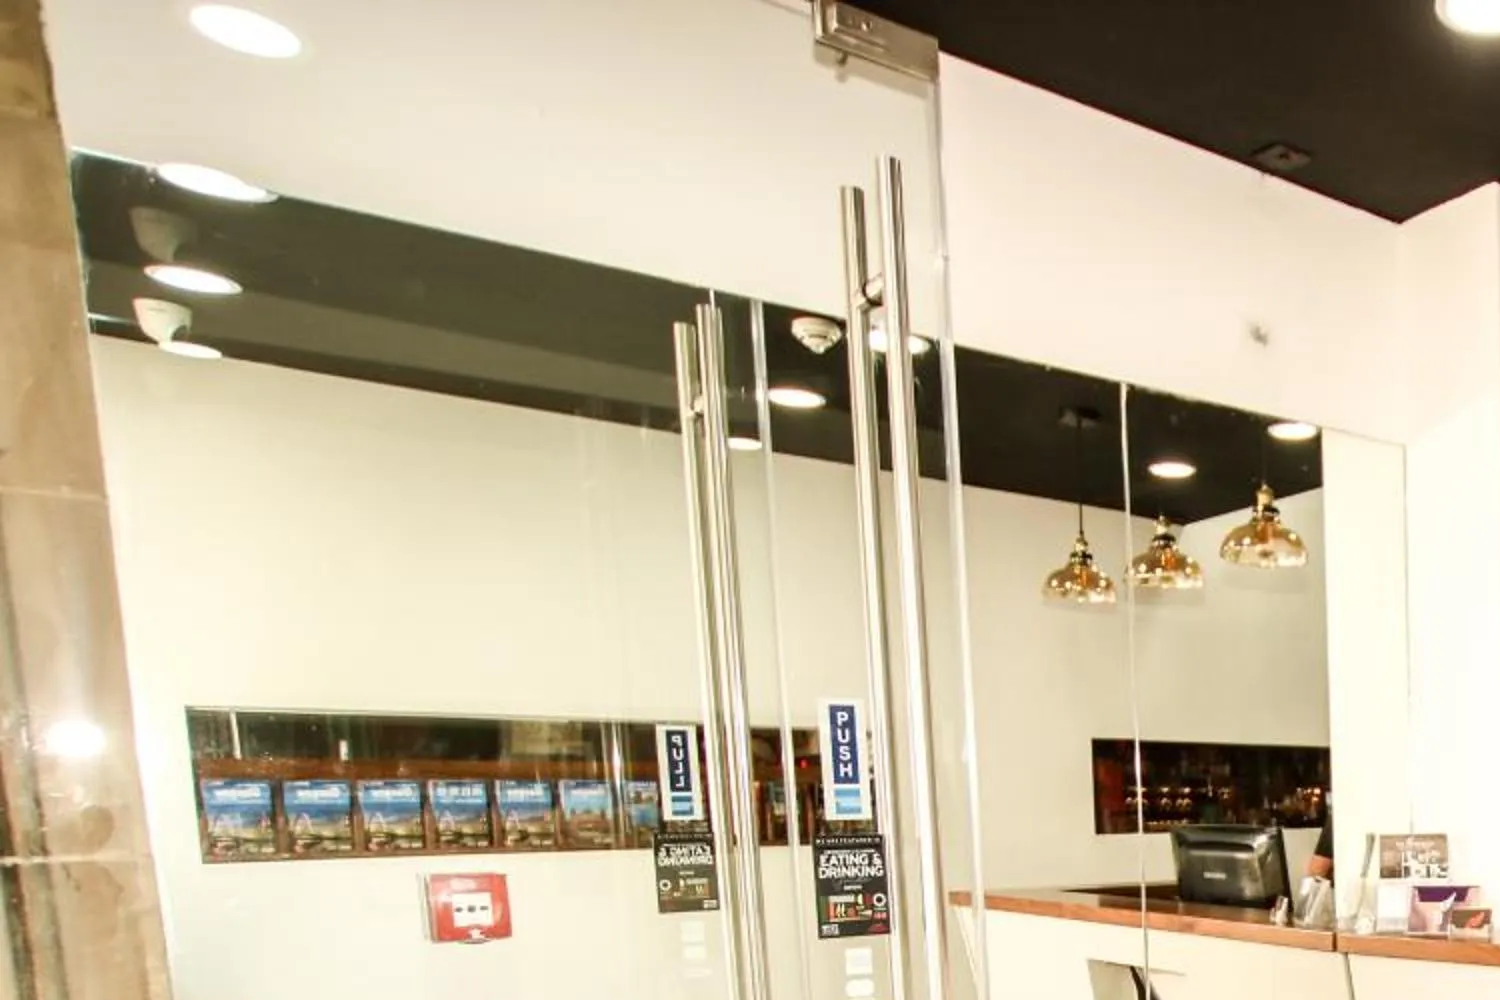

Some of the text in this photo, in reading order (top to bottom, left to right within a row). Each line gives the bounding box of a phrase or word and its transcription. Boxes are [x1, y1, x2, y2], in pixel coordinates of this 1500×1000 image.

[836, 711, 854, 778] PUSH
[819, 852, 883, 867] EATING &
[818, 865, 885, 879] DRINKING
